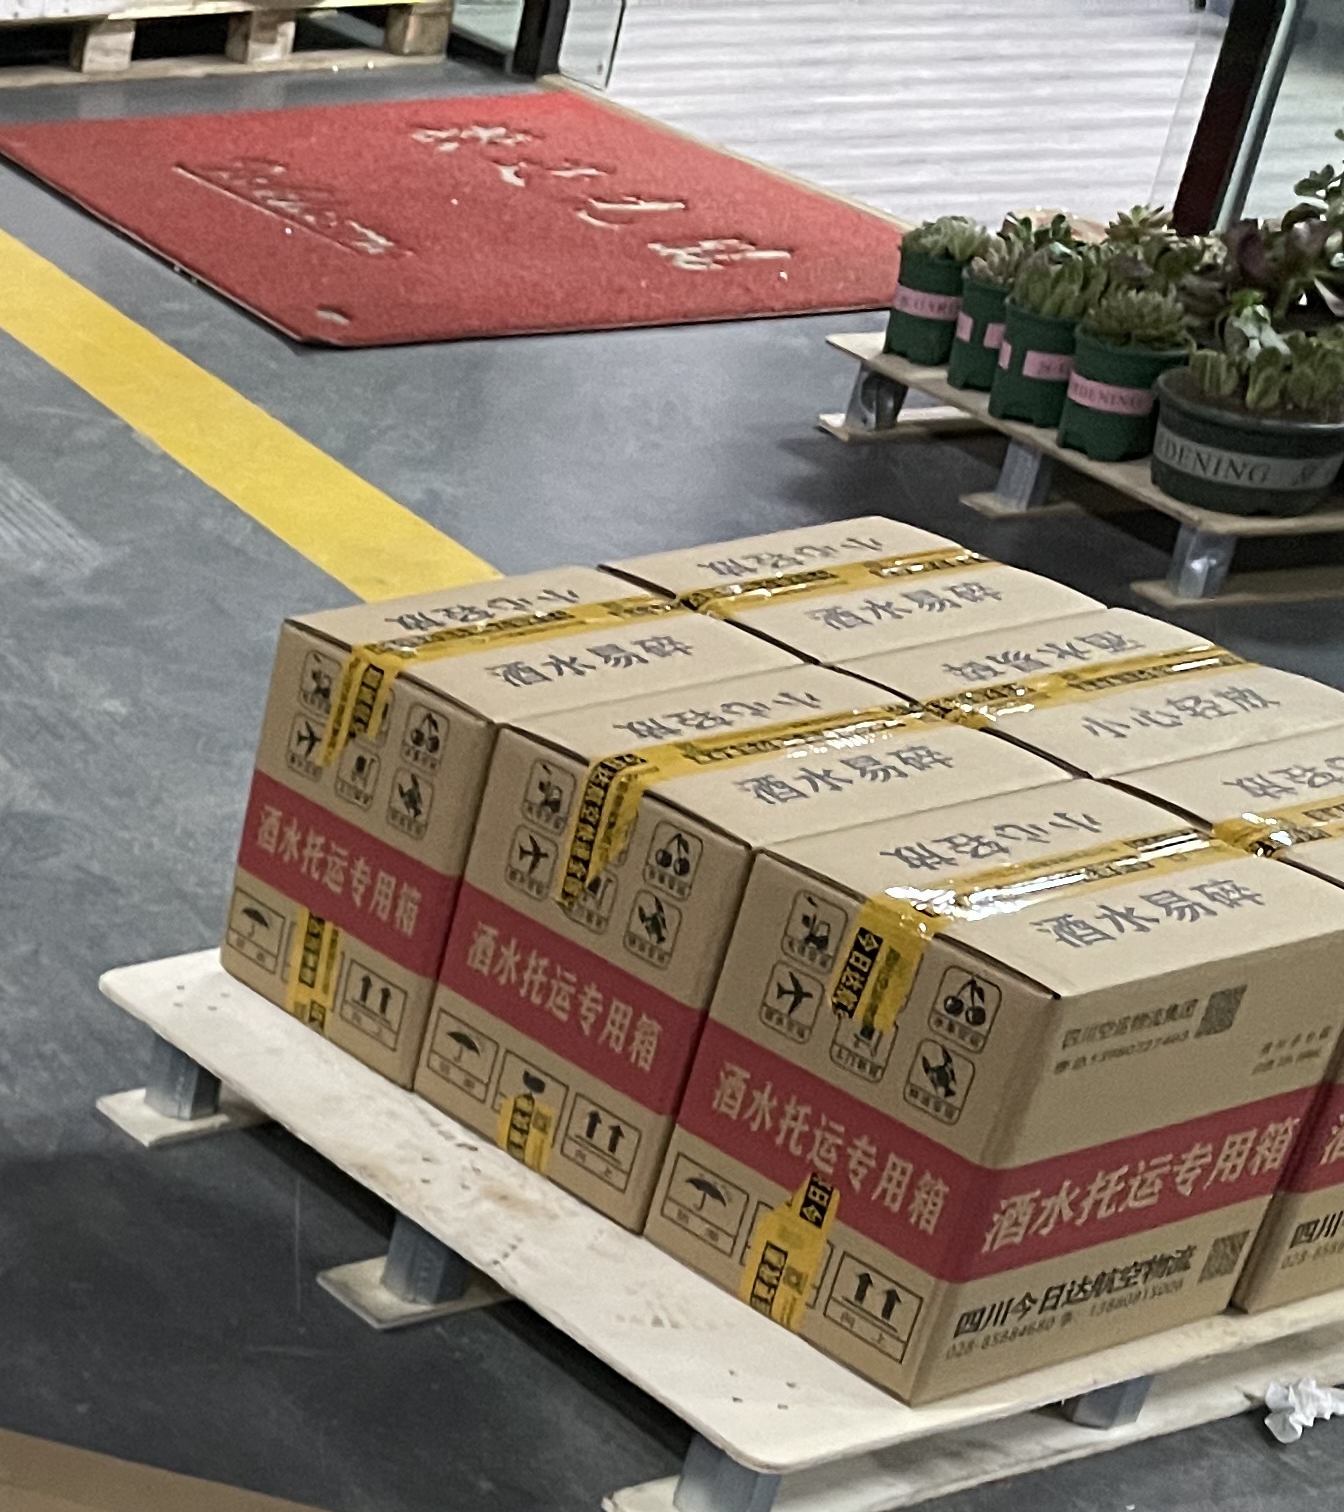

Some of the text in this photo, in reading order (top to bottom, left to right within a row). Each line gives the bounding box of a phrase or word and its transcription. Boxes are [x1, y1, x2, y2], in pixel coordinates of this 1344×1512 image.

[730, 745, 953, 804] 酒水易碎
[257, 804, 421, 937] 酒水托运专用箱
[1029, 879, 1265, 948] 酒水易碎
[466, 920, 663, 1074] 酒水托运专用箱
[712, 1060, 950, 1236] 酒水托运专用箱
[980, 1117, 1300, 1256] 酒水托运专用箱
